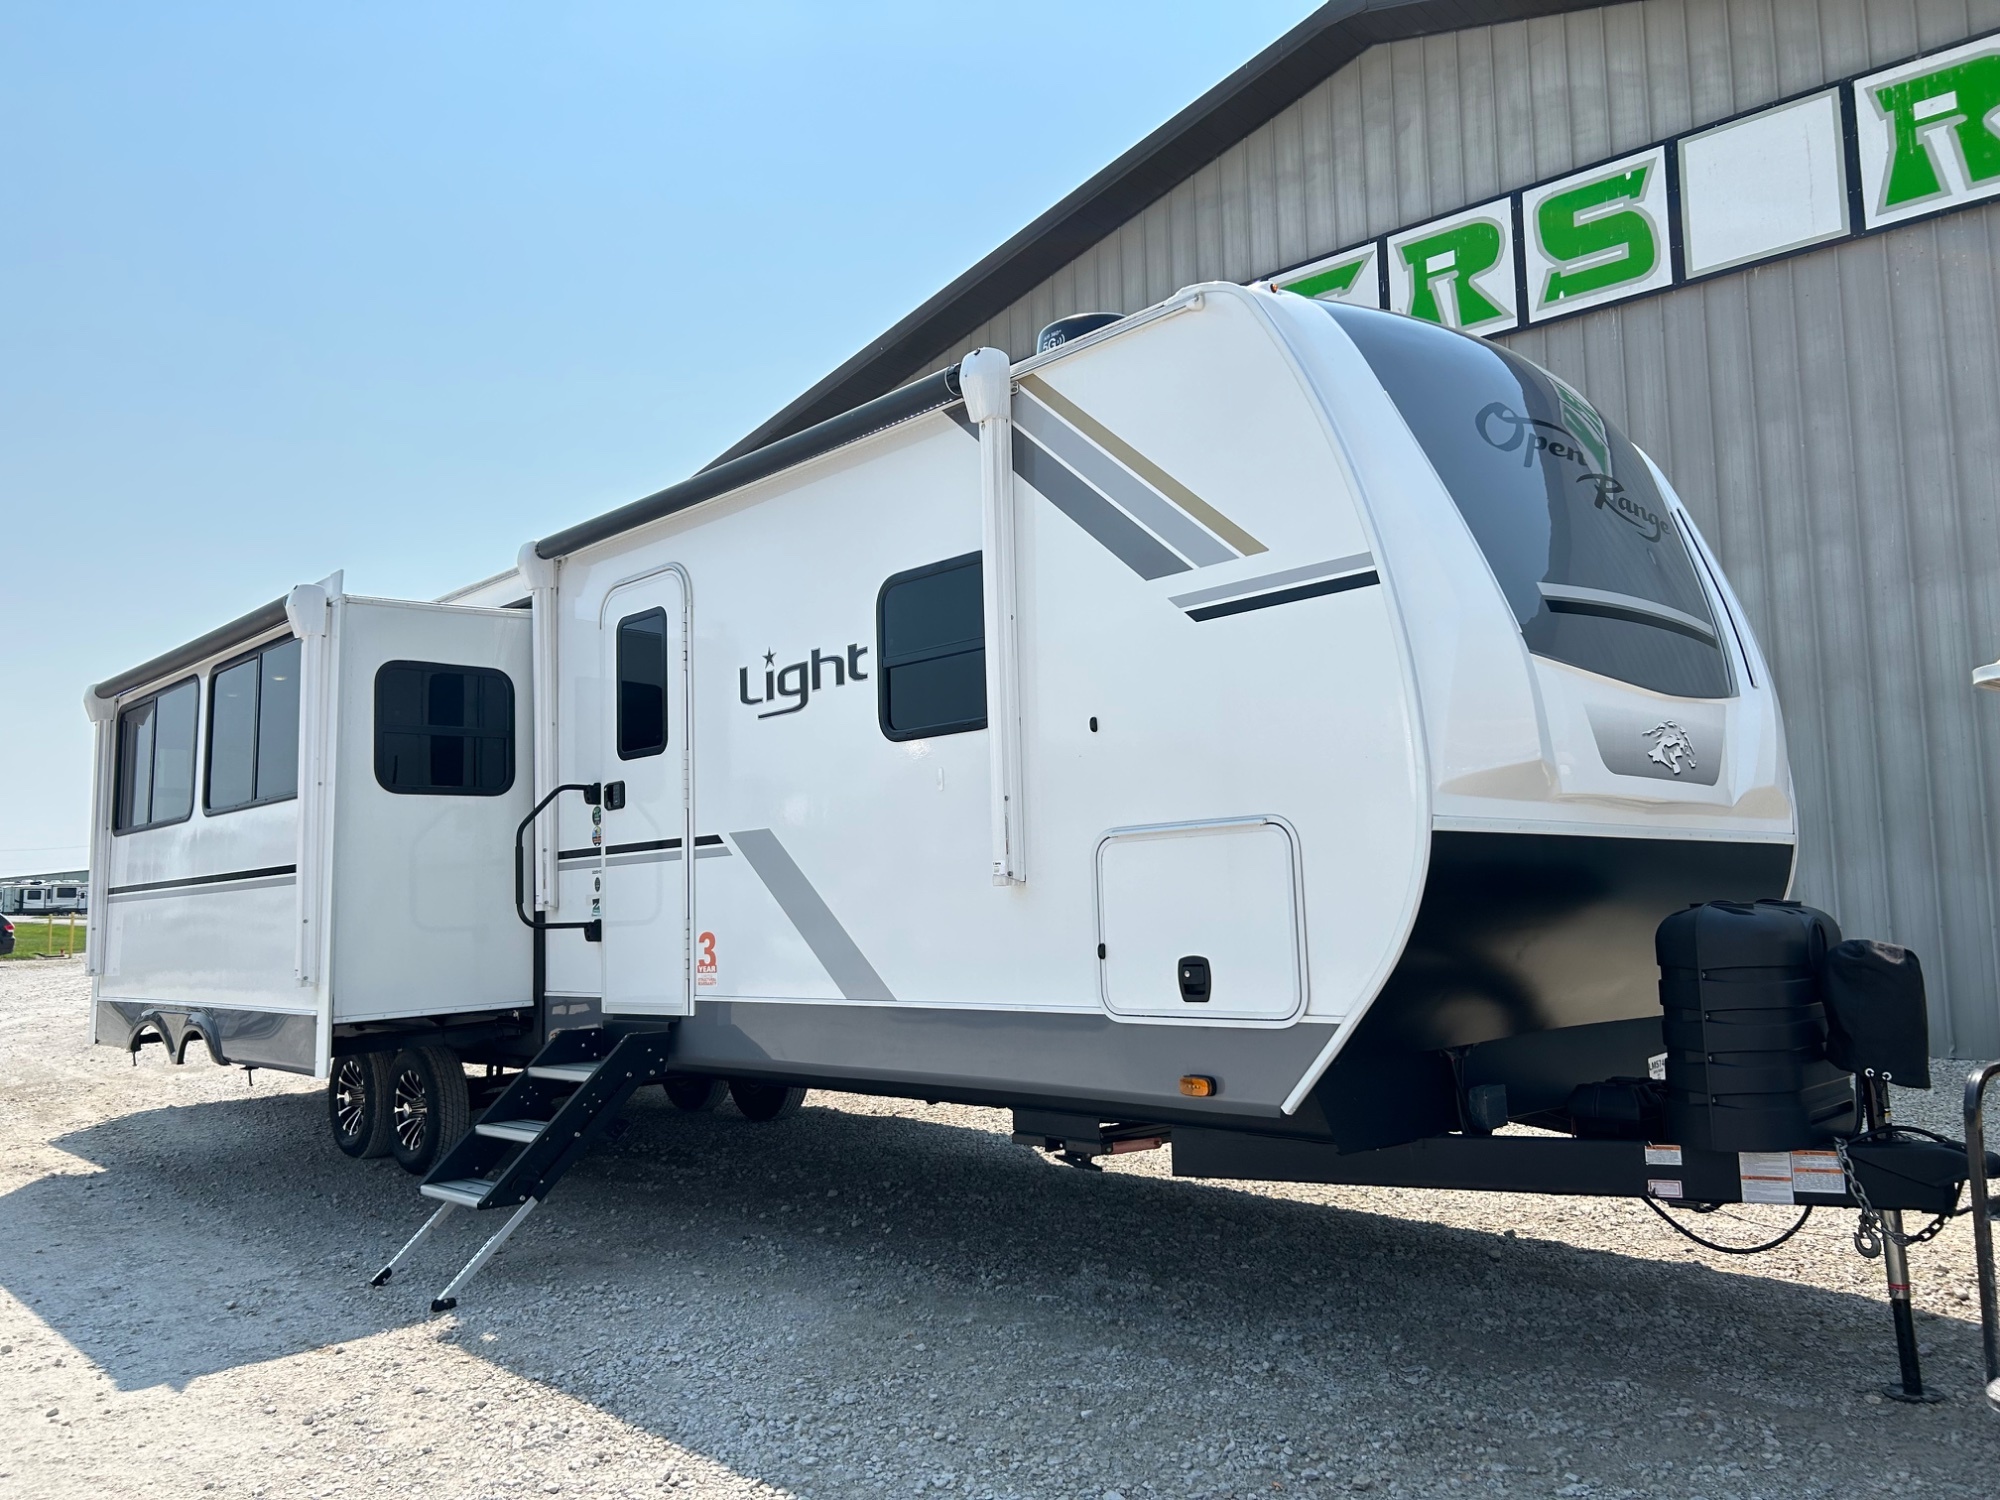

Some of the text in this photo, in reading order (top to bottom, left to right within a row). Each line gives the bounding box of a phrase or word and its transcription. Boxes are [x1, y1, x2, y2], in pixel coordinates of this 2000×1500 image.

[1283, 164, 1658, 327] RS
[1475, 402, 1588, 468] Open
[1576, 473, 1670, 543] Range
[739, 643, 868, 720] Light
[698, 931, 716, 966] 3
[698, 965, 716, 973] YEAR
